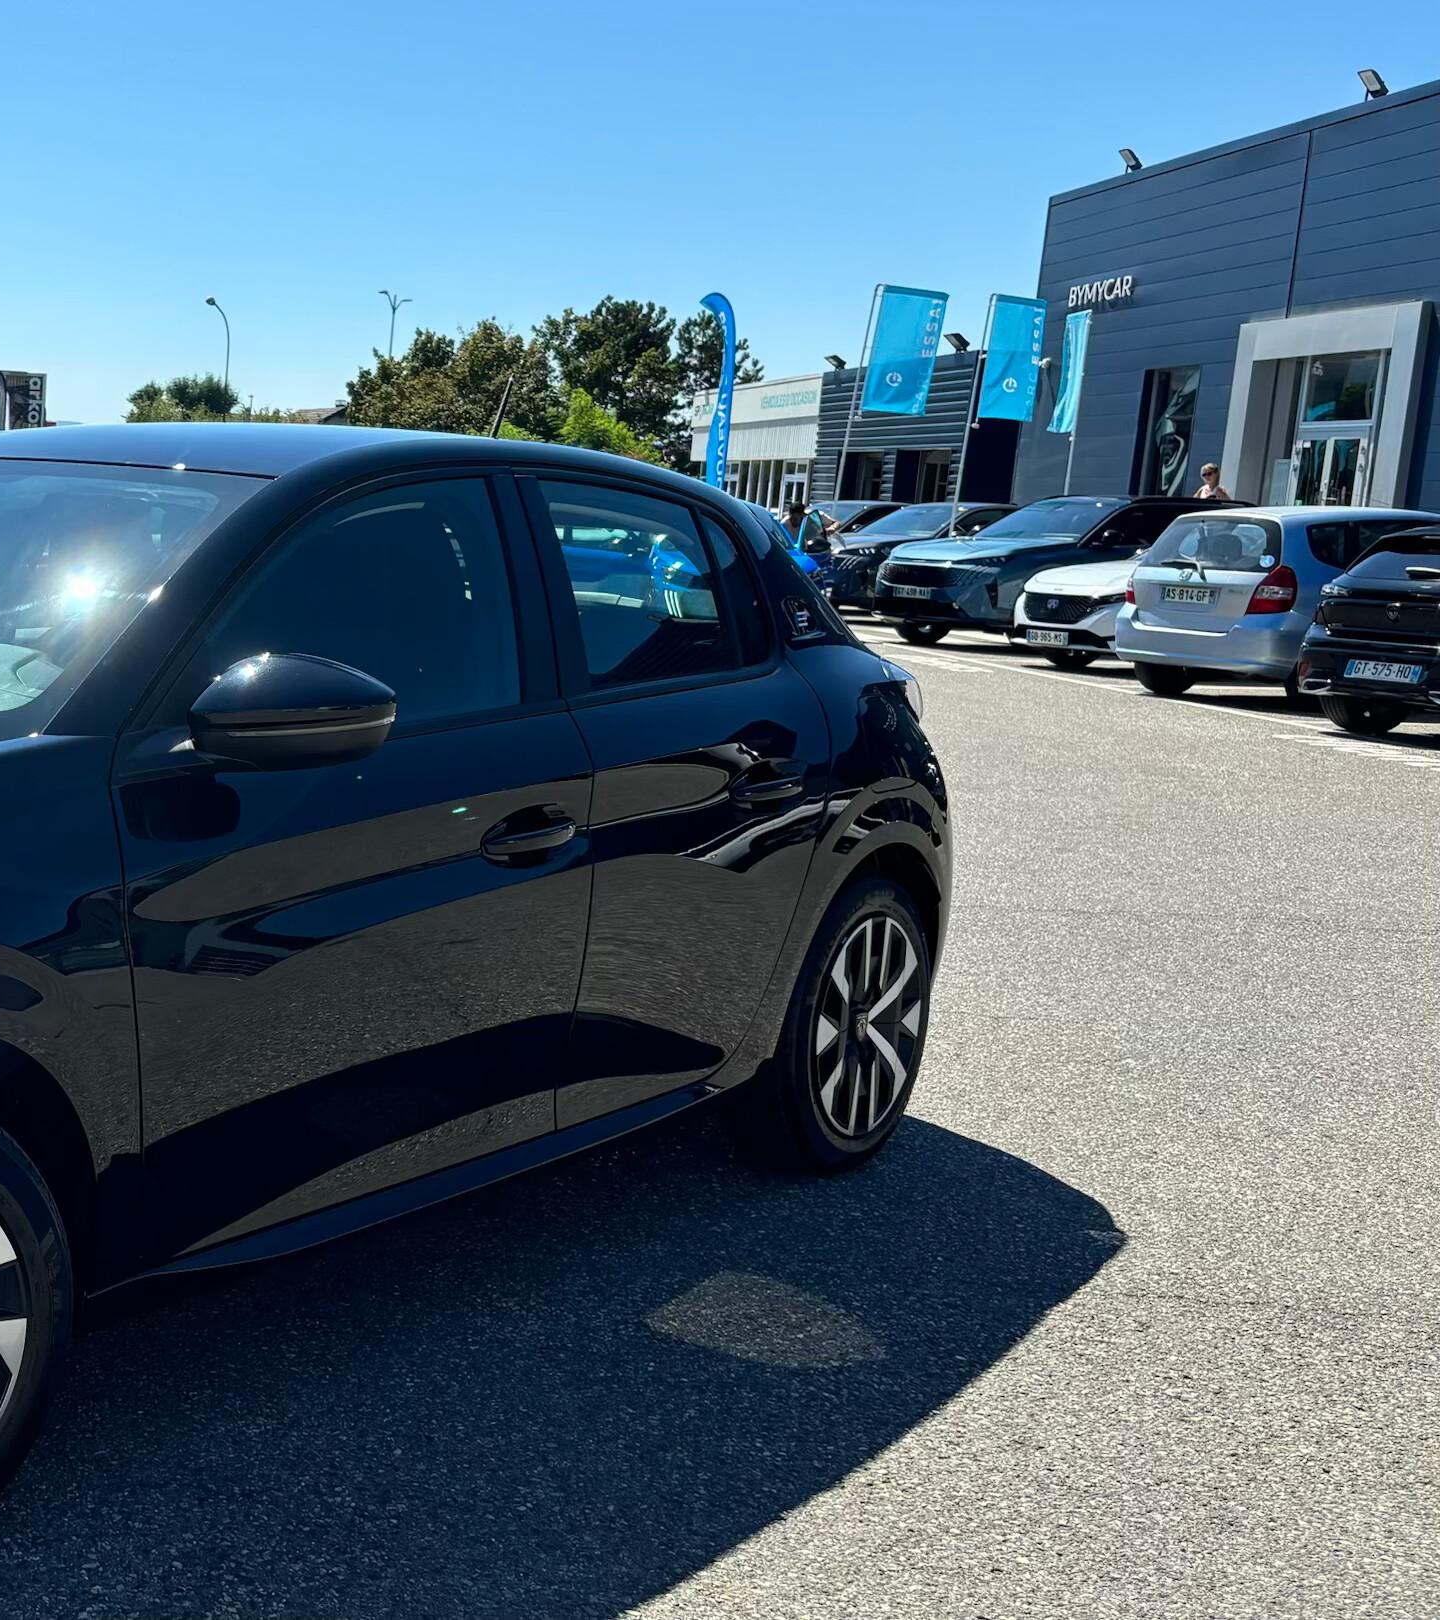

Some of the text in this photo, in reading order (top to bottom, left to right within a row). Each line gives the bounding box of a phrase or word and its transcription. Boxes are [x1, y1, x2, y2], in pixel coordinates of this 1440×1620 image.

[1068, 275, 1132, 307] BYMYCAR
[921, 299, 944, 358] ESSAI
[1031, 307, 1046, 366] ESSAI
[27, 377, 44, 427] arko
